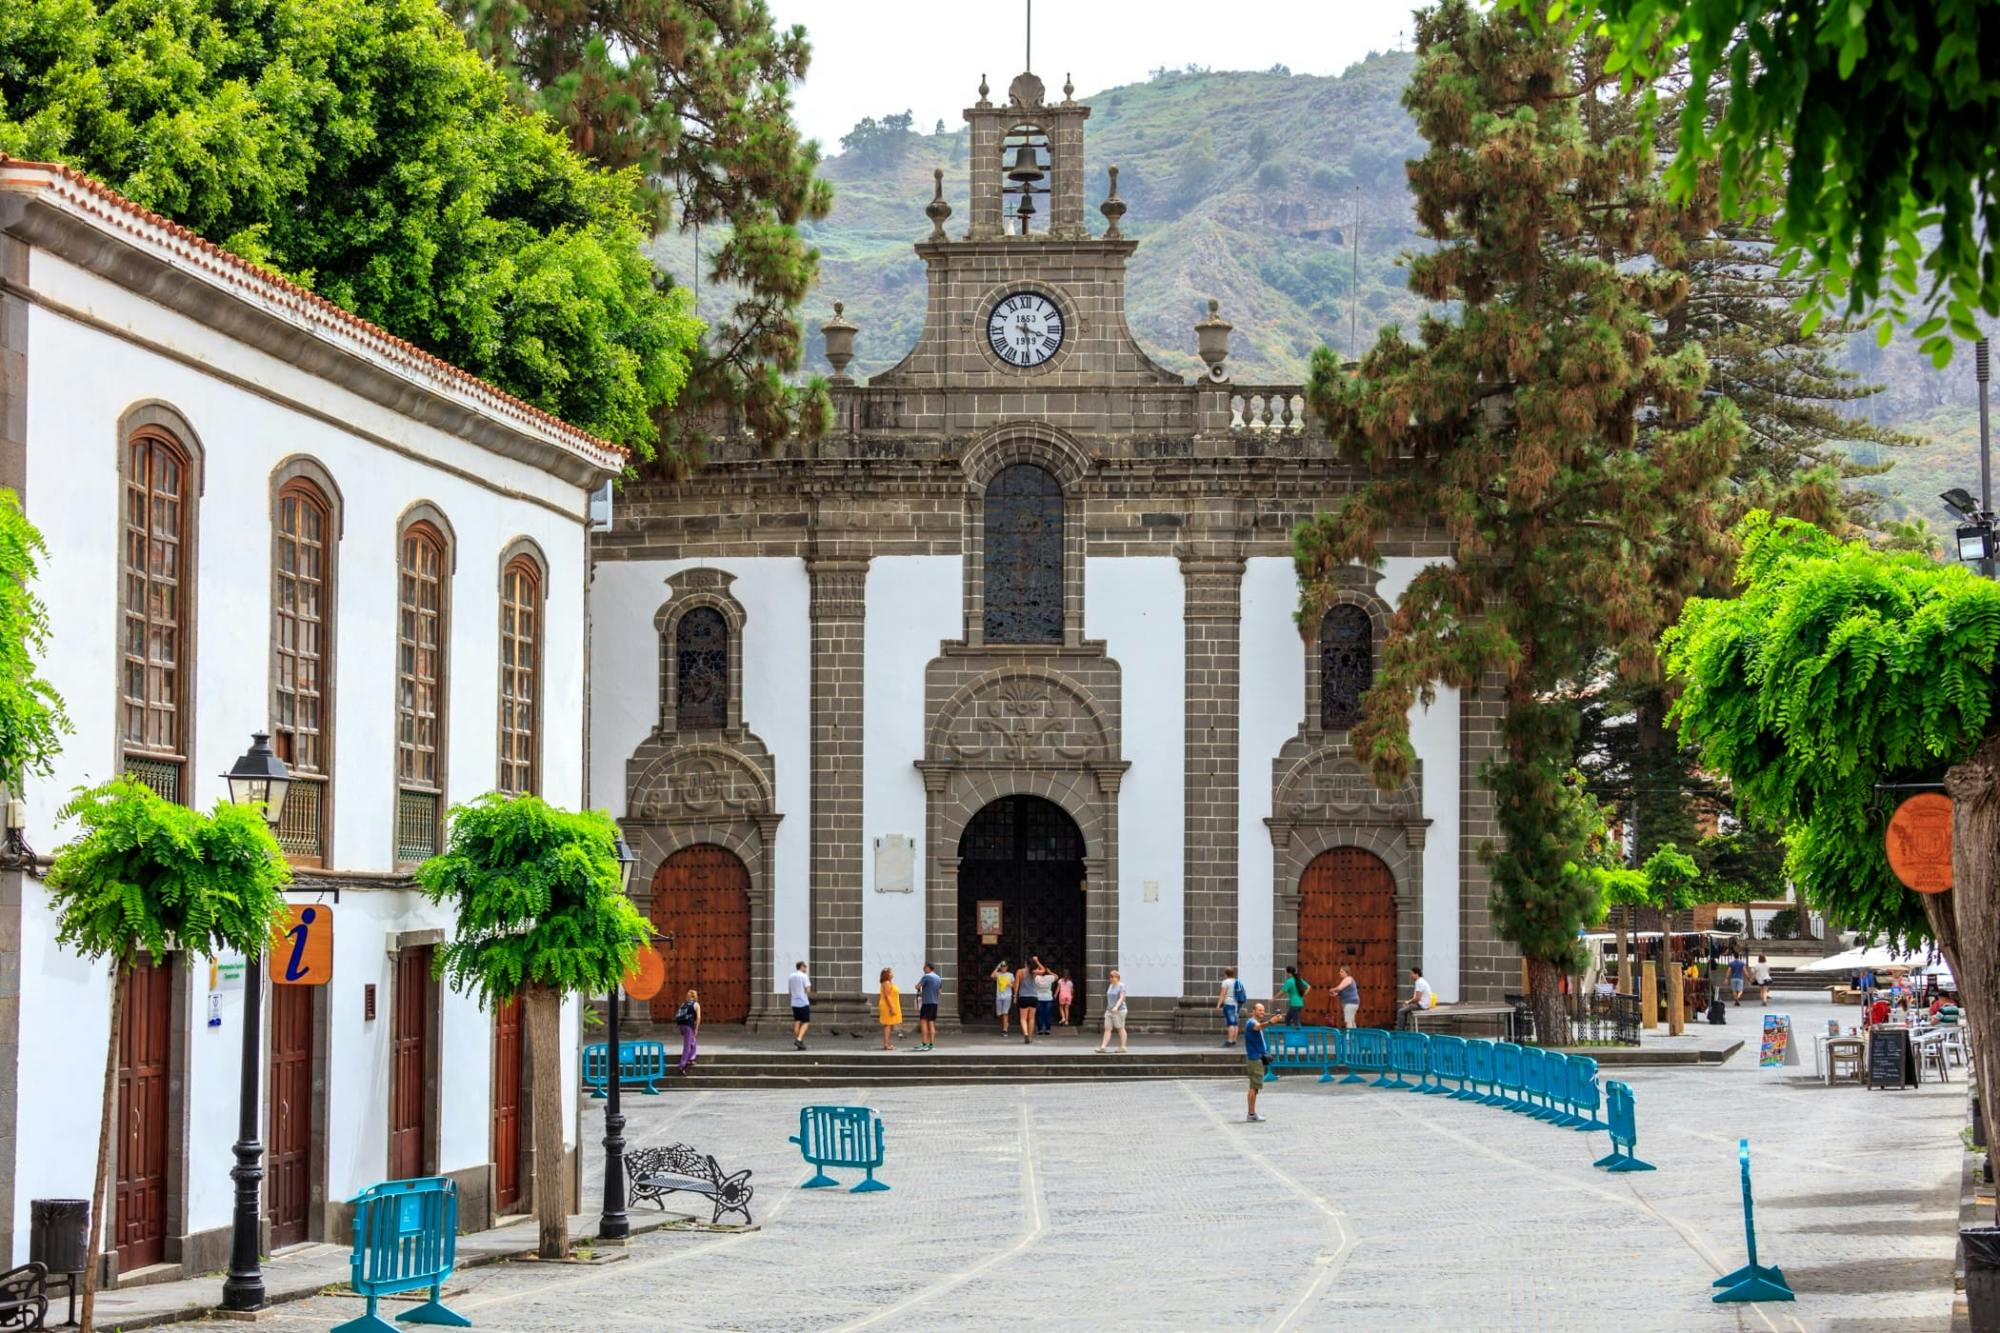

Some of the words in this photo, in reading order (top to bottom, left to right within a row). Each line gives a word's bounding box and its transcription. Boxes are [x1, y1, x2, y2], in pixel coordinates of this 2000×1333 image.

[1005, 299, 1018, 314] XI
[1020, 296, 1032, 309] XII
[1036, 300, 1044, 312] I
[995, 311, 1008, 321] X
[1016, 315, 1037, 323] 1853
[1044, 311, 1056, 322] II
[991, 326, 1004, 335] IX
[1047, 325, 1060, 334] III
[994, 336, 1009, 352] VIII
[1004, 346, 1018, 361] VII
[1021, 351, 1030, 364] VI
[1035, 348, 1046, 361] V
